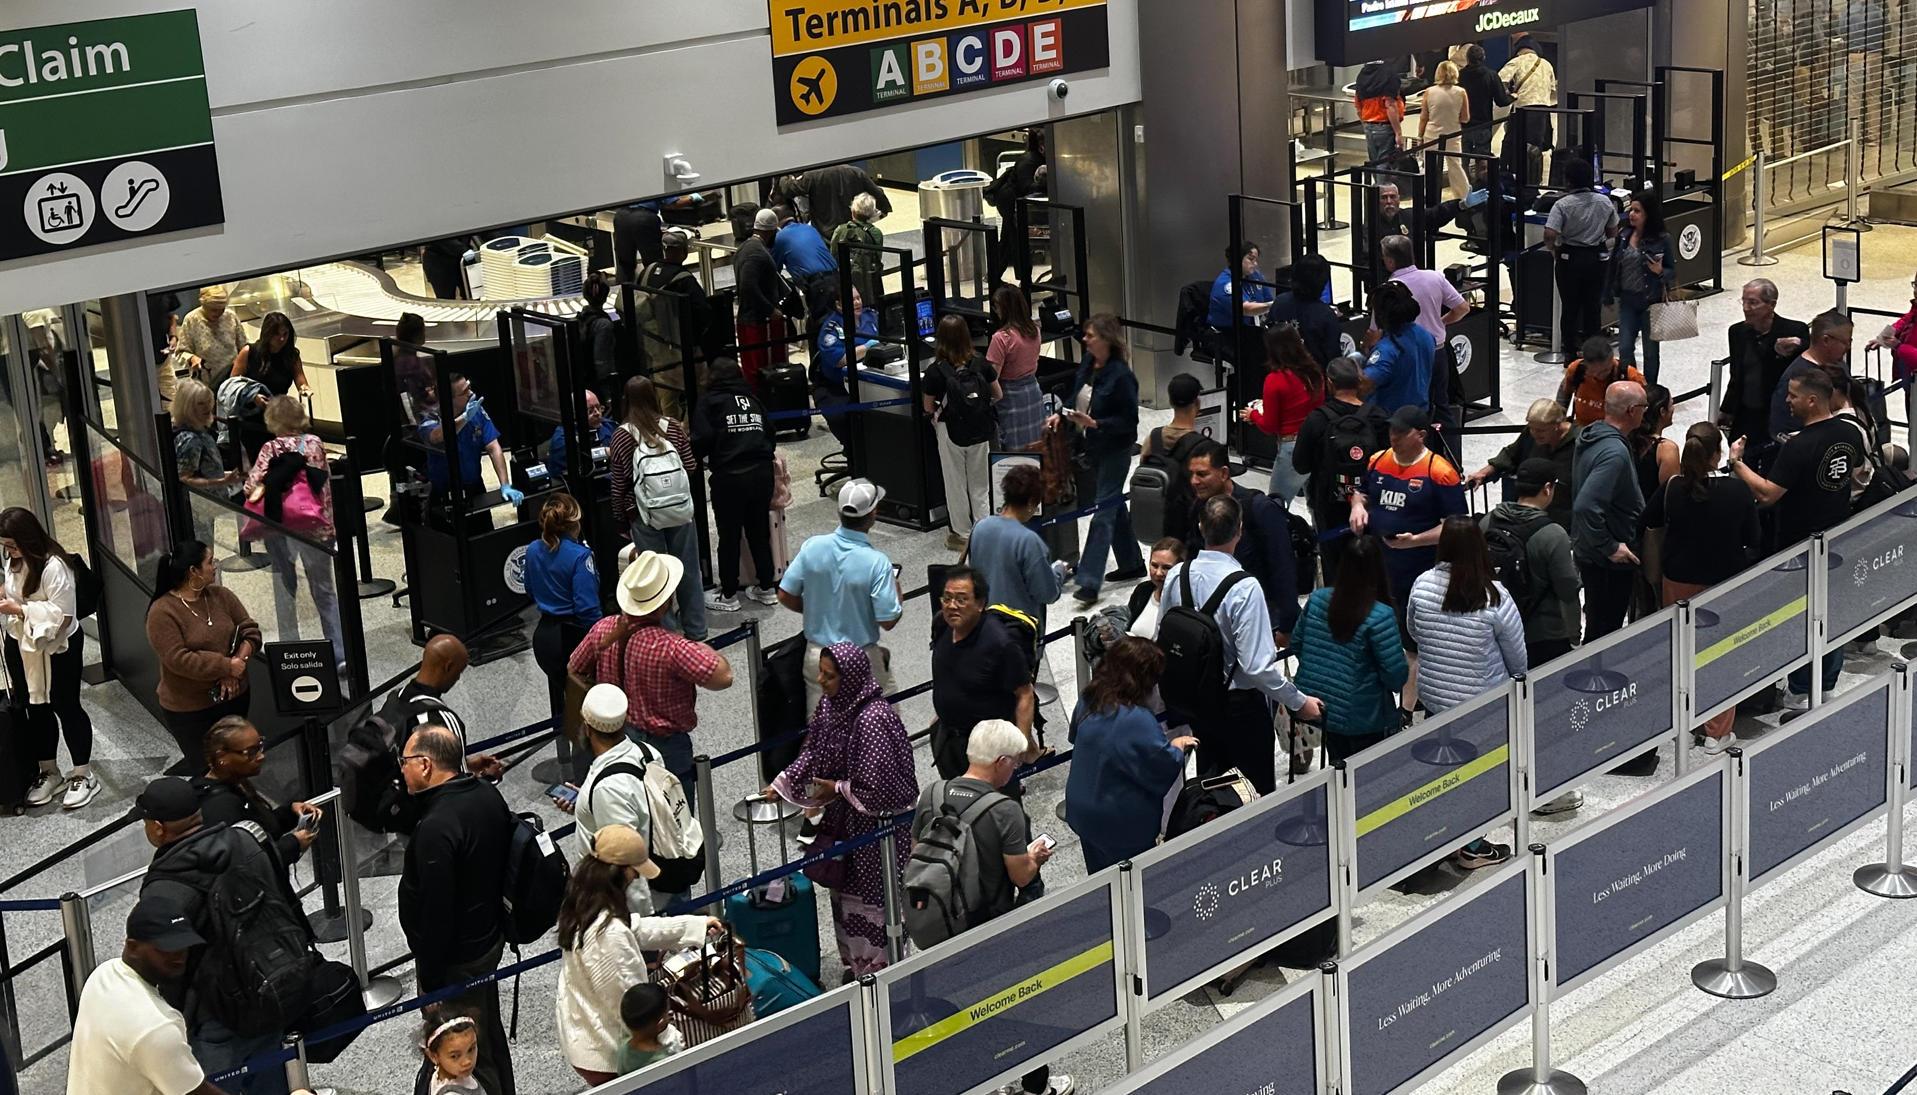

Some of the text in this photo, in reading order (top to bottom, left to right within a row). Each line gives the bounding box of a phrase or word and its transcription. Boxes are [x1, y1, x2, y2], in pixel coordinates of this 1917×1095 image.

[785, 0, 948, 42] Terminals
[1475, 8, 1540, 33] JCDecaux
[876, 22, 1057, 90] A B C D E
[876, 60, 1060, 99] TERMINAL TERMINAL TERMINAL TERMINAL TERMINAL
[1380, 489, 1406, 507] KUB
[1872, 544, 1904, 570] CLEAR
[280, 661, 323, 671] Solo salida
[283, 650, 317, 660] Exit only
[1596, 682, 1637, 712] CLEAR
[1408, 773, 1461, 806] Welcome Back
[1770, 751, 1867, 812] Less Waiting, More Adventuring
[1228, 858, 1283, 896] CLEAR
[1265, 874, 1283, 889] PLUS
[1593, 847, 1687, 905] Less Waiting, More Doing
[969, 979, 1043, 1021] Welcome Back
[1378, 946, 1502, 1031] Less Waiting, More Adventuring
[214, 1070, 241, 1082] UNITED
